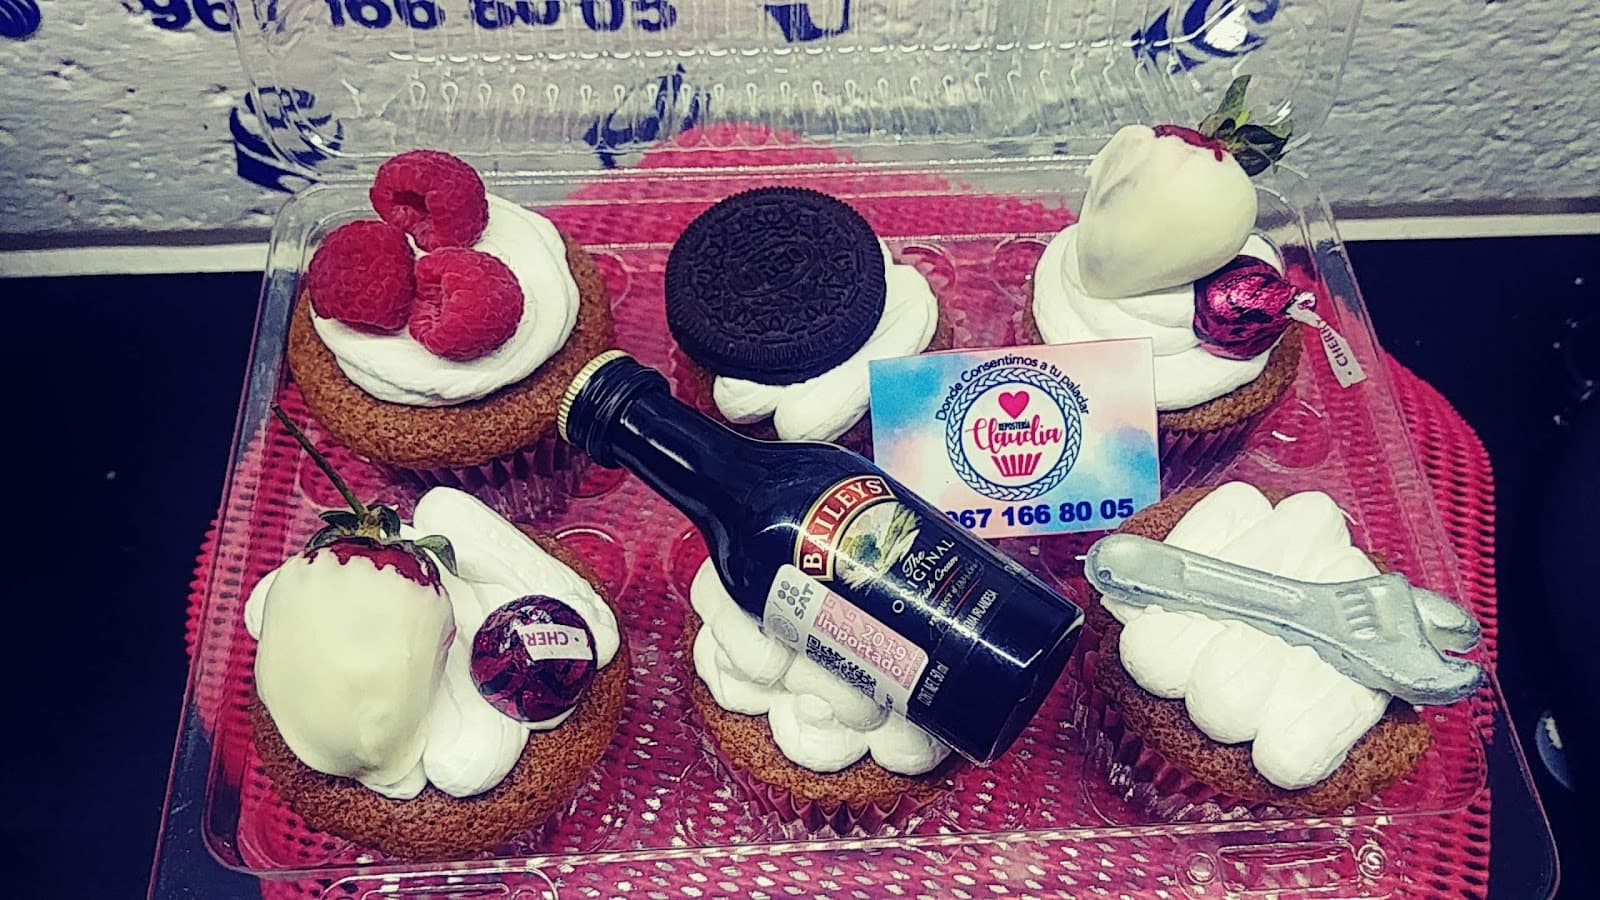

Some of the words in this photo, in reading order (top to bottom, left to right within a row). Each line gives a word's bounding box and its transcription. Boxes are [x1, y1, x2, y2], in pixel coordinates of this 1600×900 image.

[935, 381, 963, 421] Donde
[960, 353, 1038, 383] Consentimos
[1039, 361, 1048, 371] a
[1049, 365, 1062, 378] tu
[1059, 375, 1089, 415] paladar
[965, 414, 1063, 455] Claudia
[803, 480, 884, 571] BAILEYS
[1001, 504, 1050, 527] 166
[1059, 501, 1092, 523] 80
[1100, 498, 1134, 520] 05
[902, 551, 925, 577] The
[794, 583, 814, 620] SAT
[521, 631, 569, 647] CHER
[817, 613, 902, 678] Importado
[861, 624, 907, 661] 2019
